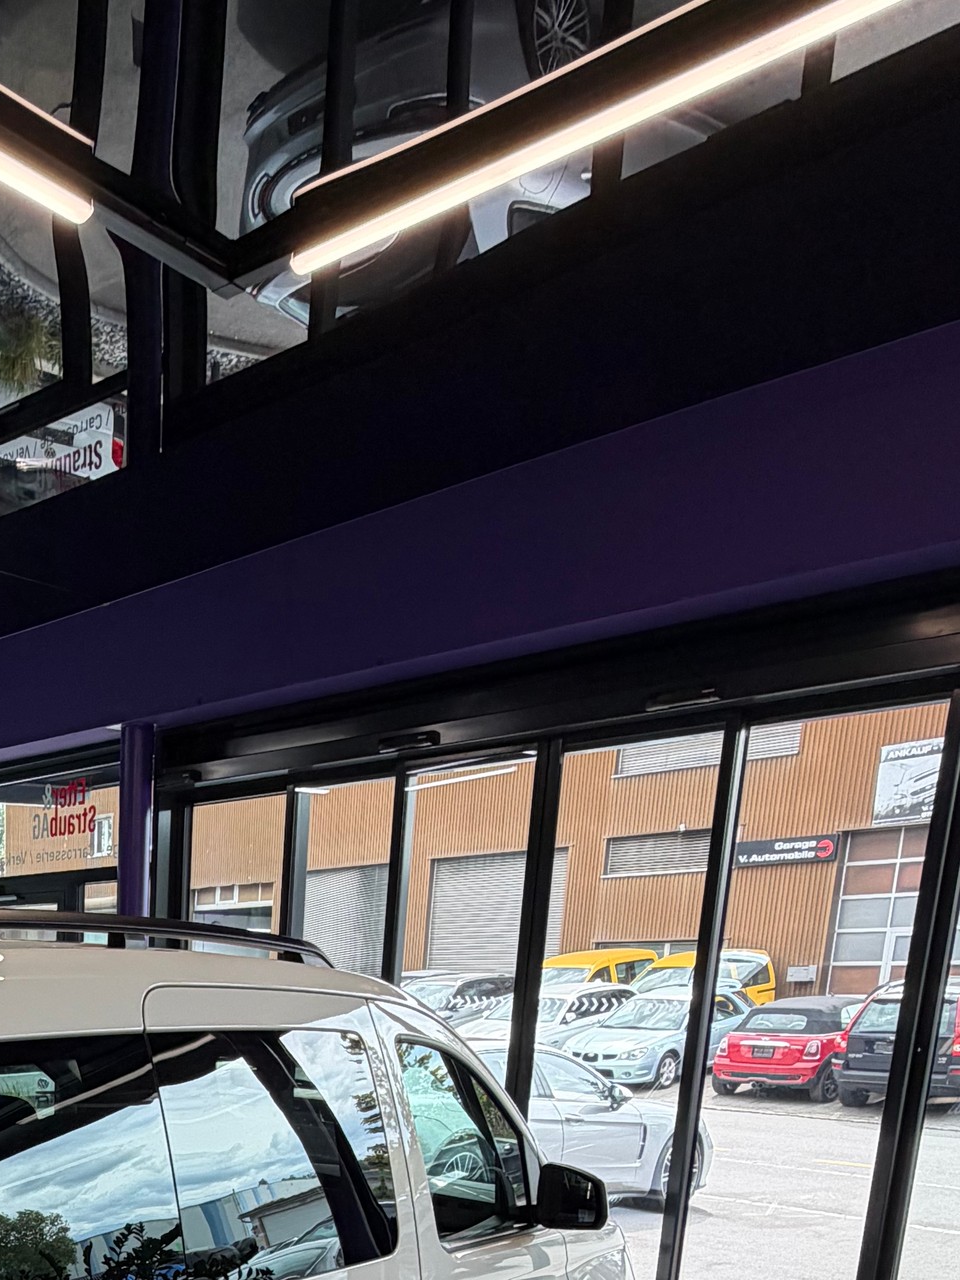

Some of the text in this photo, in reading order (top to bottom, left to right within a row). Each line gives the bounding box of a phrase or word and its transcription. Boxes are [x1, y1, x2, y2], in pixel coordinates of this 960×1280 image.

[887, 744, 932, 760] ANKAUF
[774, 840, 817, 850] Garage
[749, 850, 816, 863] Automobile
